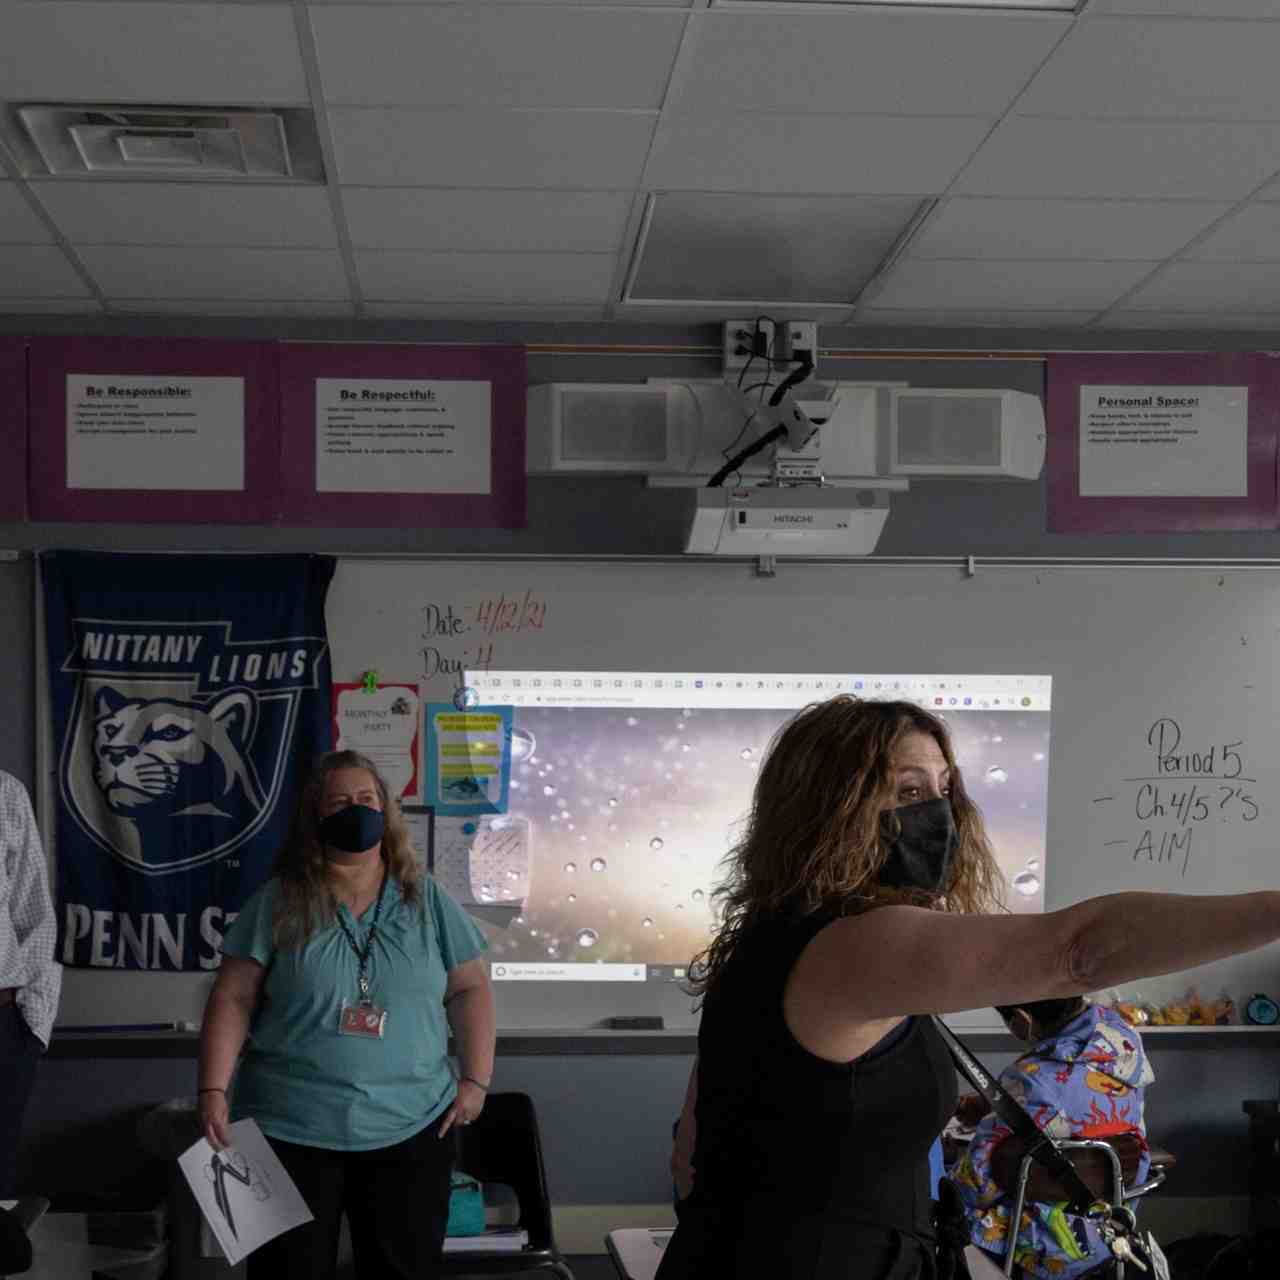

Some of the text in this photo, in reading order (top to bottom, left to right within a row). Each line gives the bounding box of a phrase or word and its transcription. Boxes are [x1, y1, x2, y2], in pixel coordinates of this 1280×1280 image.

[86, 386, 192, 399] Be Responsible:
[340, 389, 437, 402] Be Respectful:
[1098, 396, 1199, 409] Personal Space:
[774, 514, 813, 523] HITACHI
[81, 631, 203, 663] NITTANY
[207, 648, 308, 683] LIONS
[344, 709, 388, 719] MONTHLY
[363, 723, 392, 732] PARTY
[1147, 718, 1243, 779] Period 5
[1170, 785, 1211, 826] 4/5
[62, 902, 187, 970] PENN
